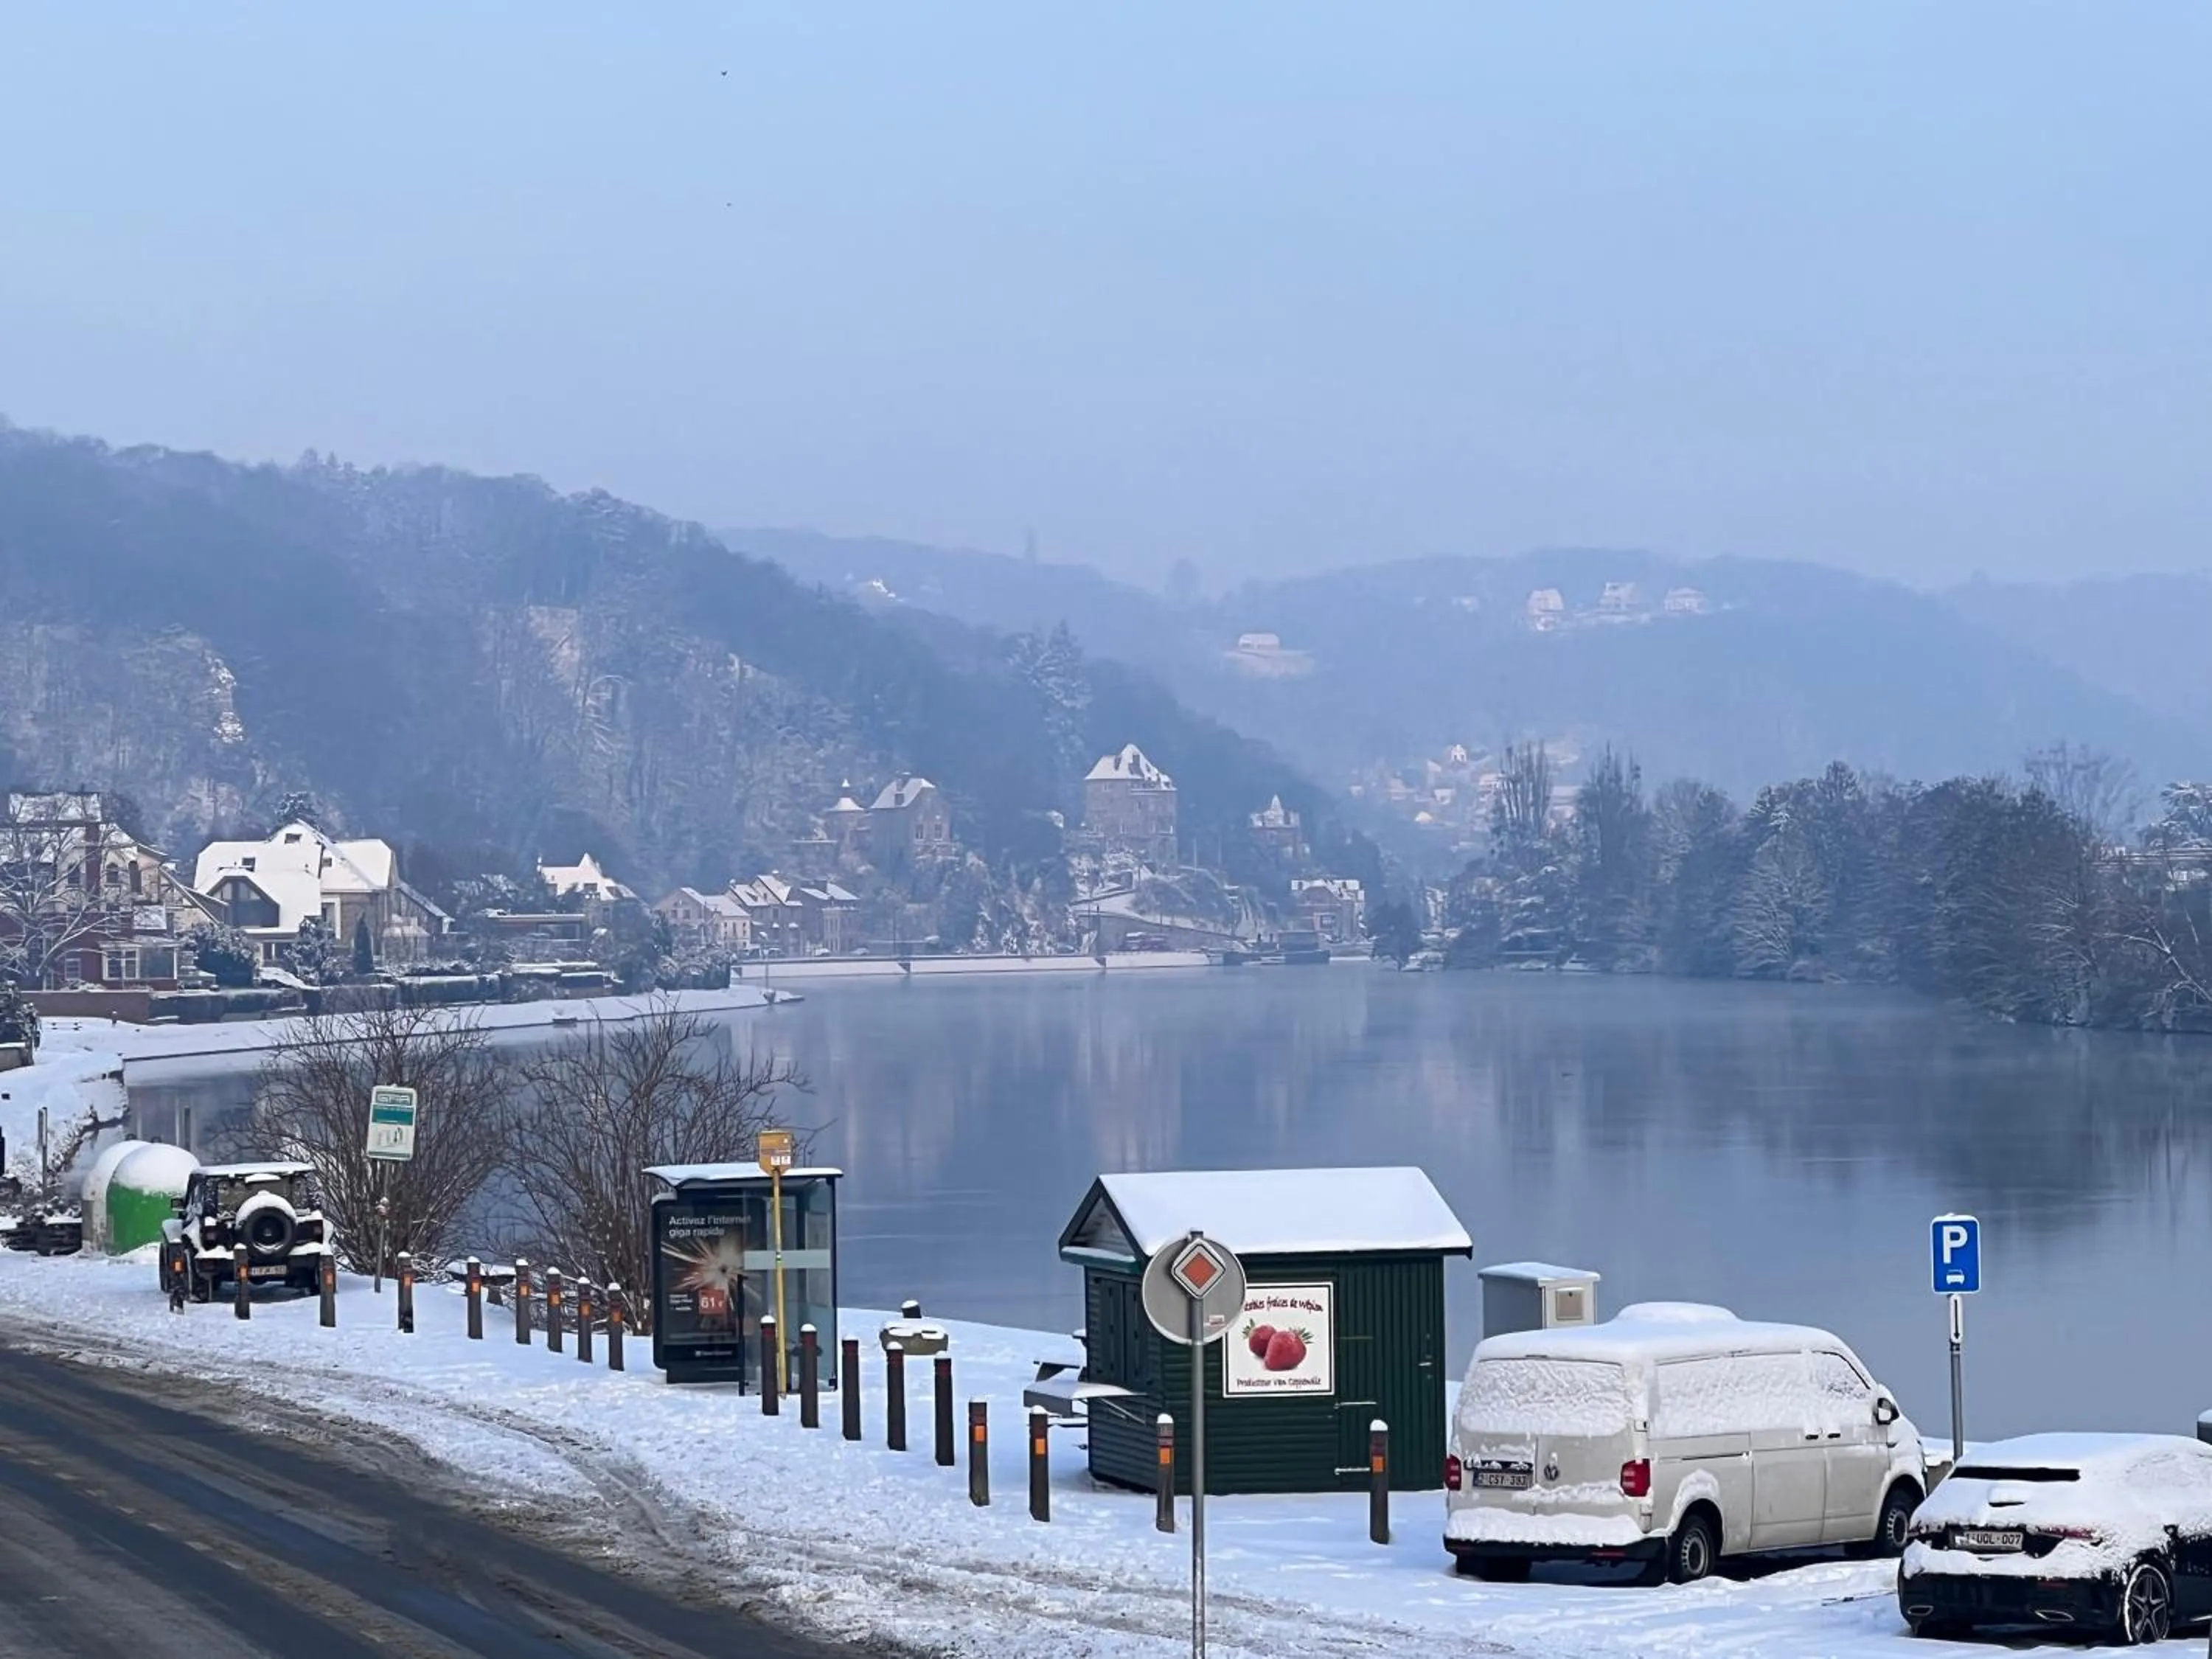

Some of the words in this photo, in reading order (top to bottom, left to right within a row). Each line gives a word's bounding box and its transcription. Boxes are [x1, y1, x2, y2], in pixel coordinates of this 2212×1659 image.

[669, 1216, 706, 1225] Activez
[669, 1228, 690, 1239] giga
[1943, 1225, 1968, 1264] P
